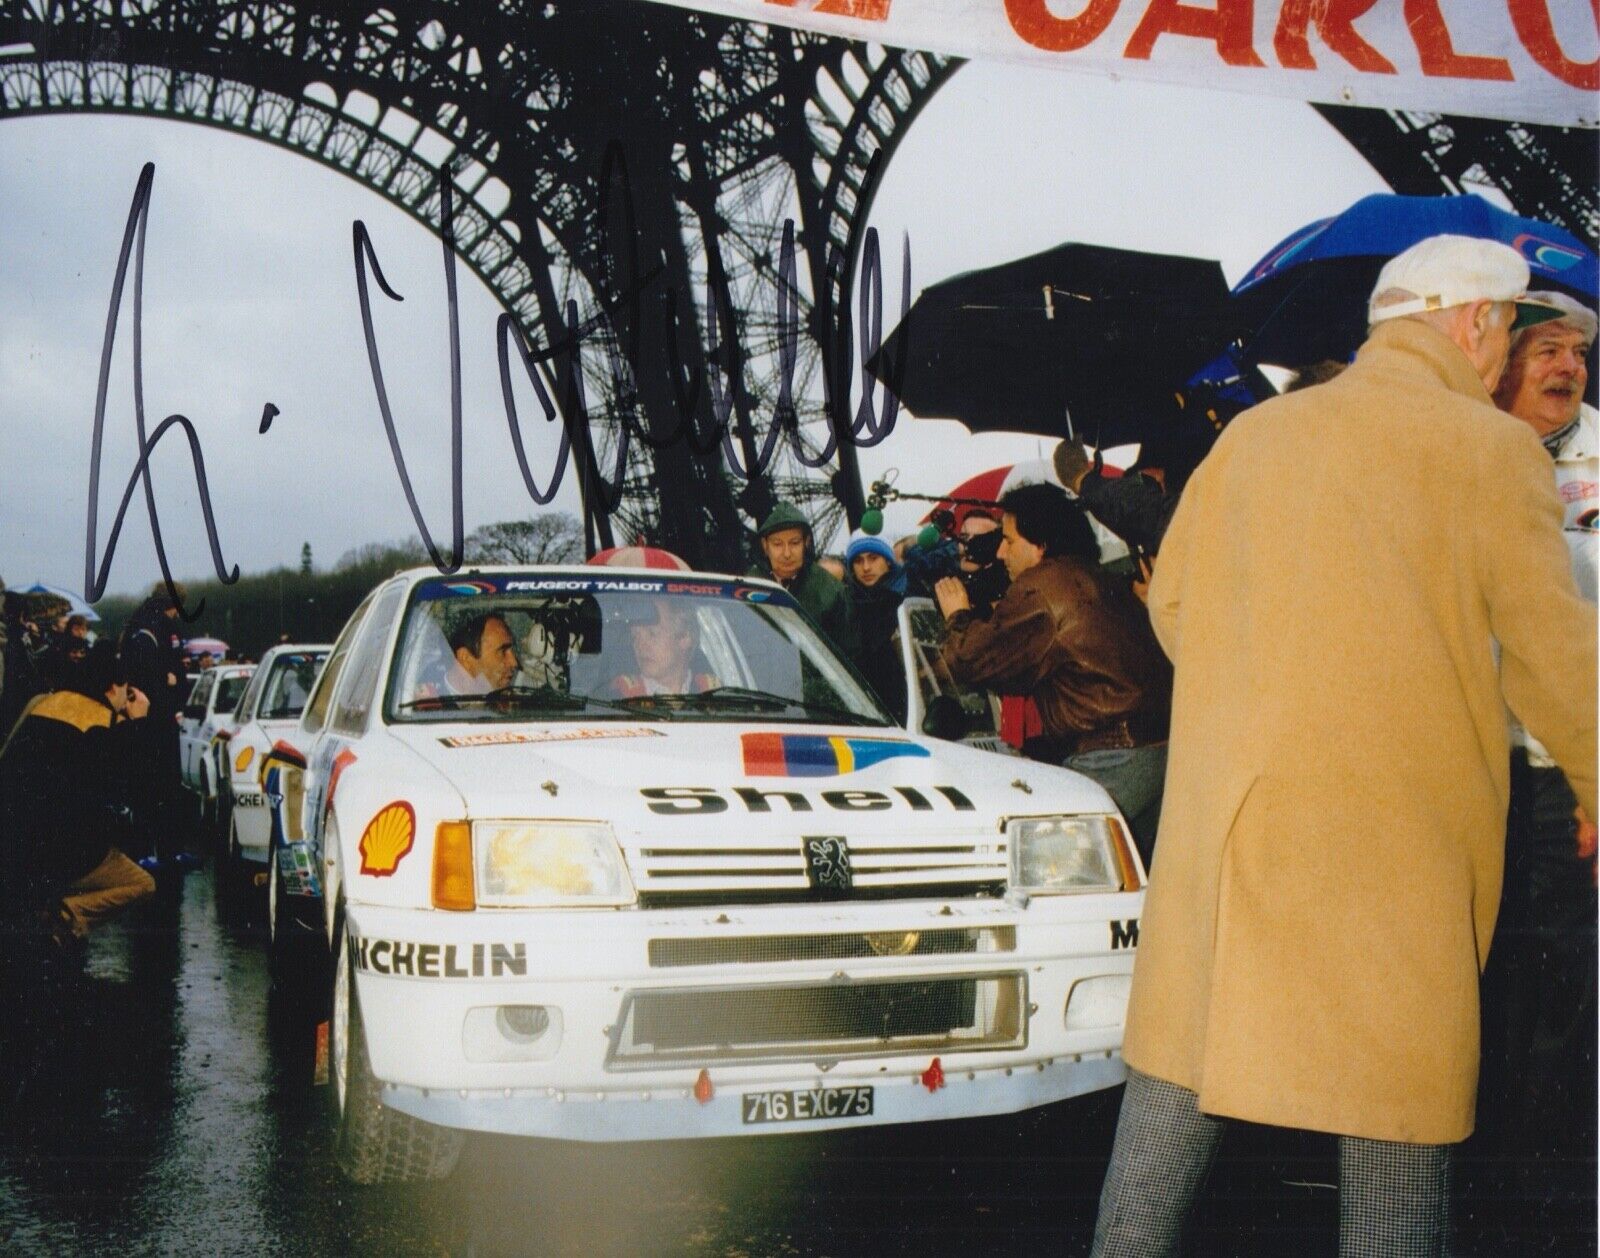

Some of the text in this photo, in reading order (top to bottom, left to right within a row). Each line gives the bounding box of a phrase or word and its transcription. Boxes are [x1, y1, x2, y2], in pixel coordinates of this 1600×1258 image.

[505, 580, 722, 595] PEUGEOT TALBOT SPORT
[639, 785, 977, 815] Shell
[746, 1092, 788, 1121] 716
